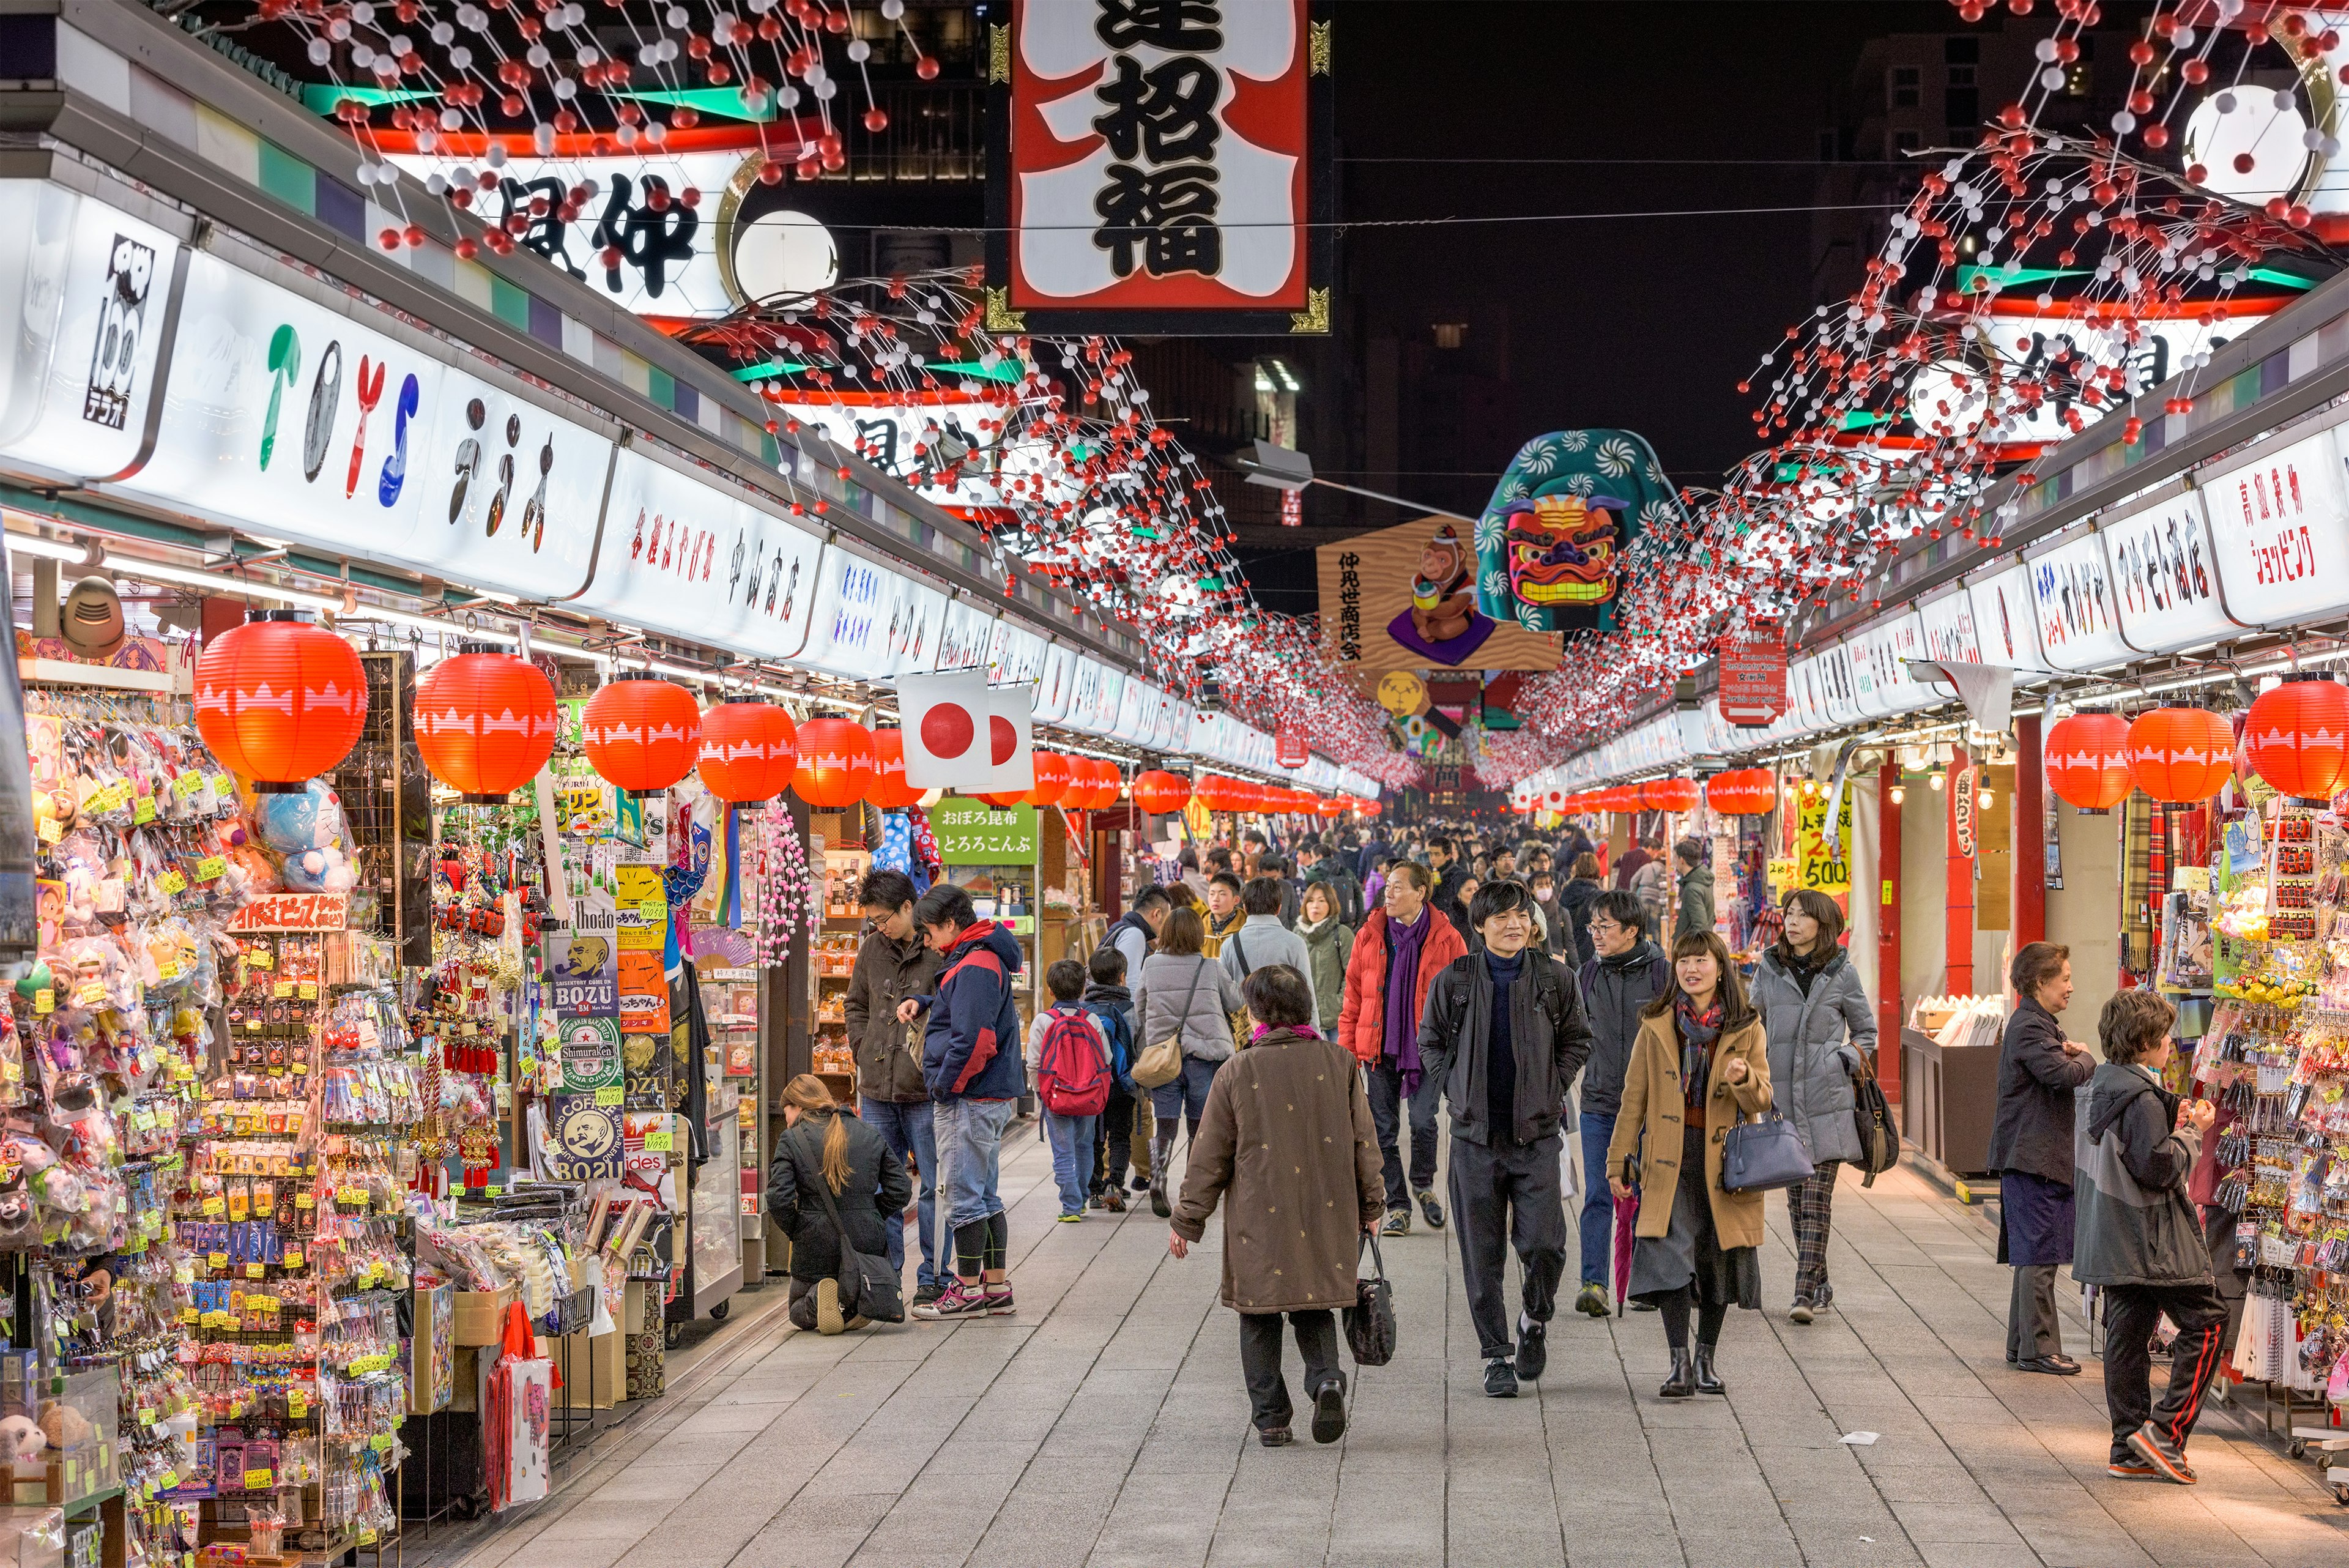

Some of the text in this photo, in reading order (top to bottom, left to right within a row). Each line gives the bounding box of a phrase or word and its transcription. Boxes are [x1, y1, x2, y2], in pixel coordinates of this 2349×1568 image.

[86, 391, 123, 428] テラオ
[260, 324, 419, 508] TOYS
[2238, 463, 2304, 527] 高級袋物
[632, 507, 714, 583] 各種みやげ物
[2250, 524, 2317, 585] ショッピング
[729, 527, 800, 623] 中山商店
[1338, 551, 1362, 661] 仲見世商店会
[1726, 694, 1748, 703] Servicio
[941, 810, 1018, 826] おぼろ昆布
[943, 835, 1031, 853] とろろこんぶ
[625, 846, 642, 862] 馬場
[641, 908, 664, 918] ¥1050
[555, 986, 612, 1006] BOZU
[562, 1019, 587, 1041] SHIMURAKEN
[562, 1046, 612, 1058] Shimuraken
[565, 1066, 587, 1083] HENNA
[597, 1094, 620, 1104] ¥1050
[646, 1141, 668, 1150] ¥1050
